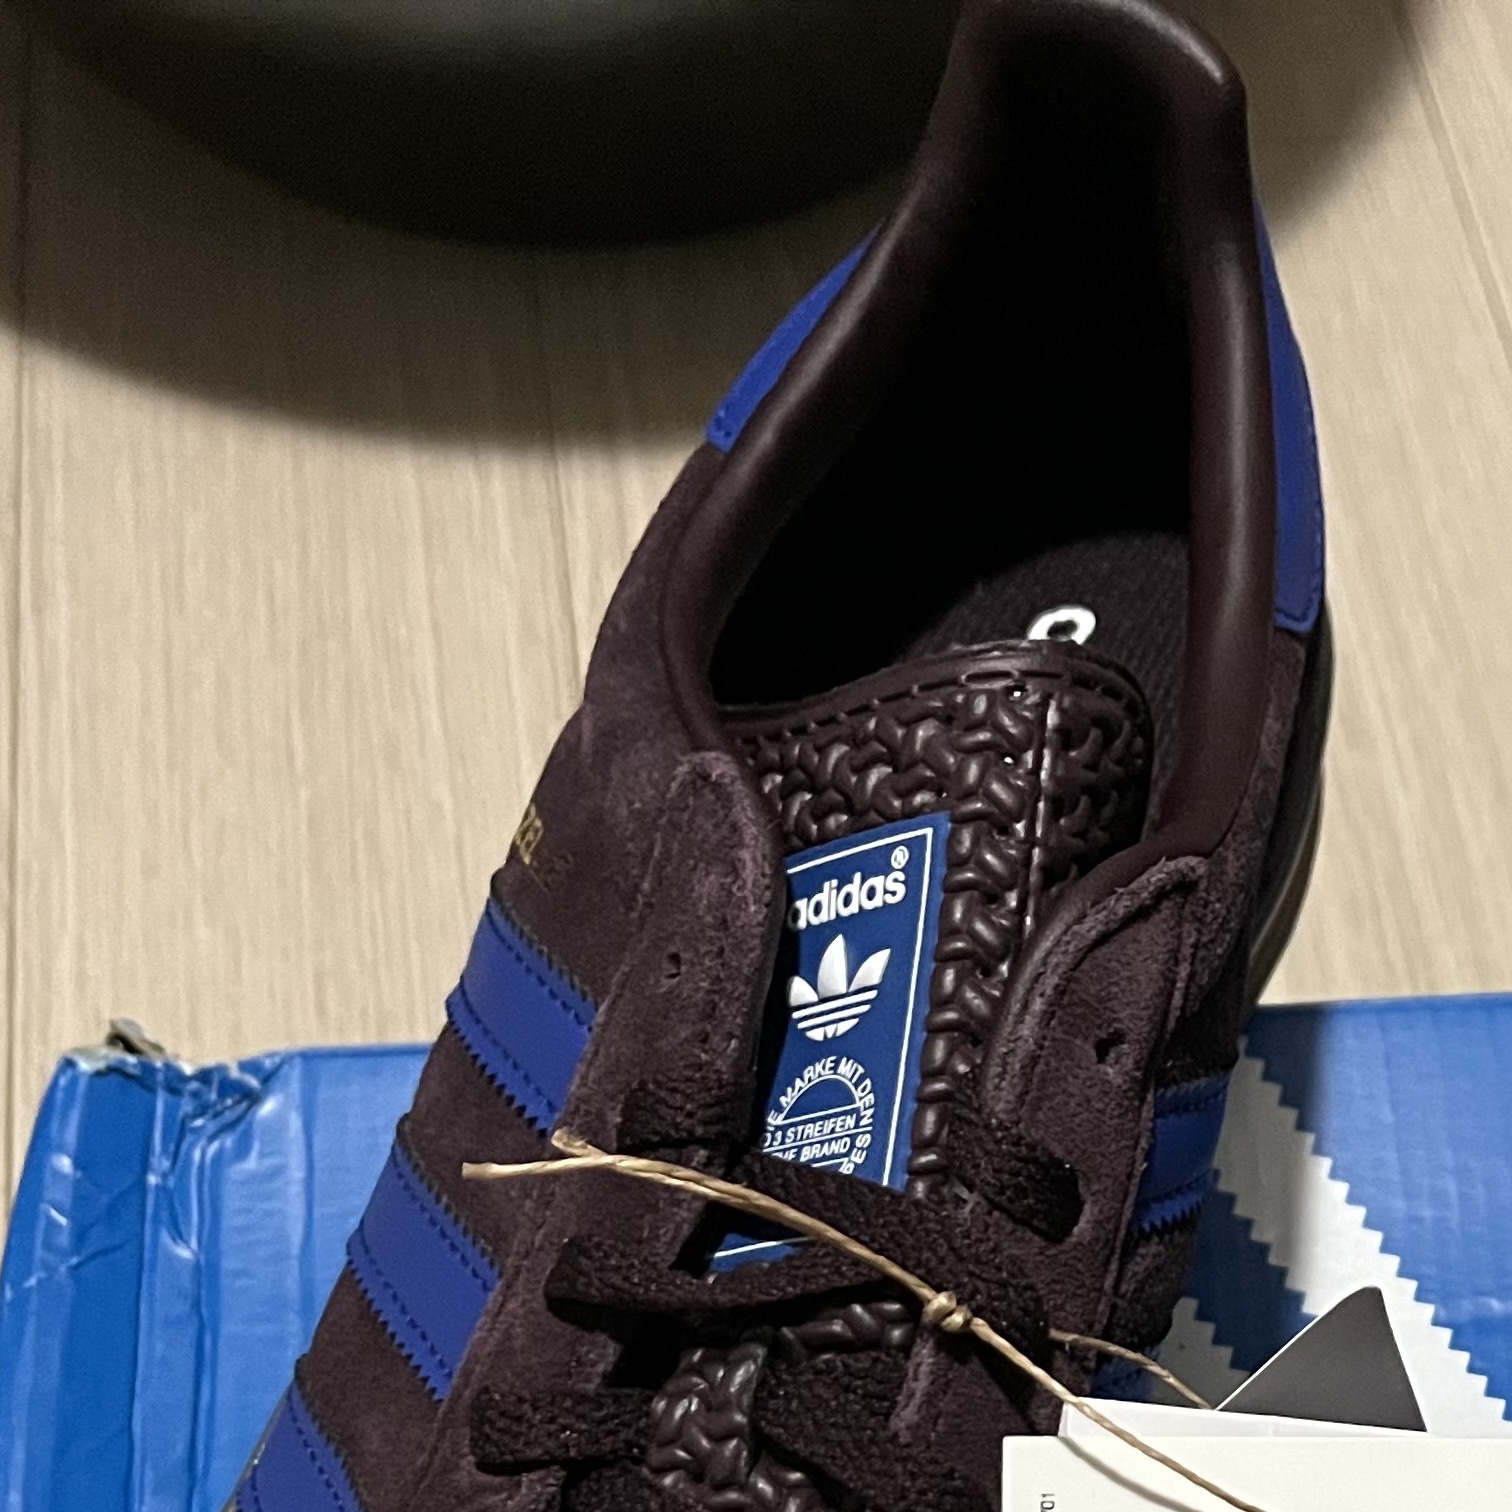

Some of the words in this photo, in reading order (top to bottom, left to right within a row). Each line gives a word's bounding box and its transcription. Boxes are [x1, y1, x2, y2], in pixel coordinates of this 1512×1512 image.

[837, 1057, 865, 1083] MIT
[857, 1078, 875, 1126] DEN
[785, 1113, 857, 1144] STREIFEN
[799, 1136, 851, 1162] BRAND
